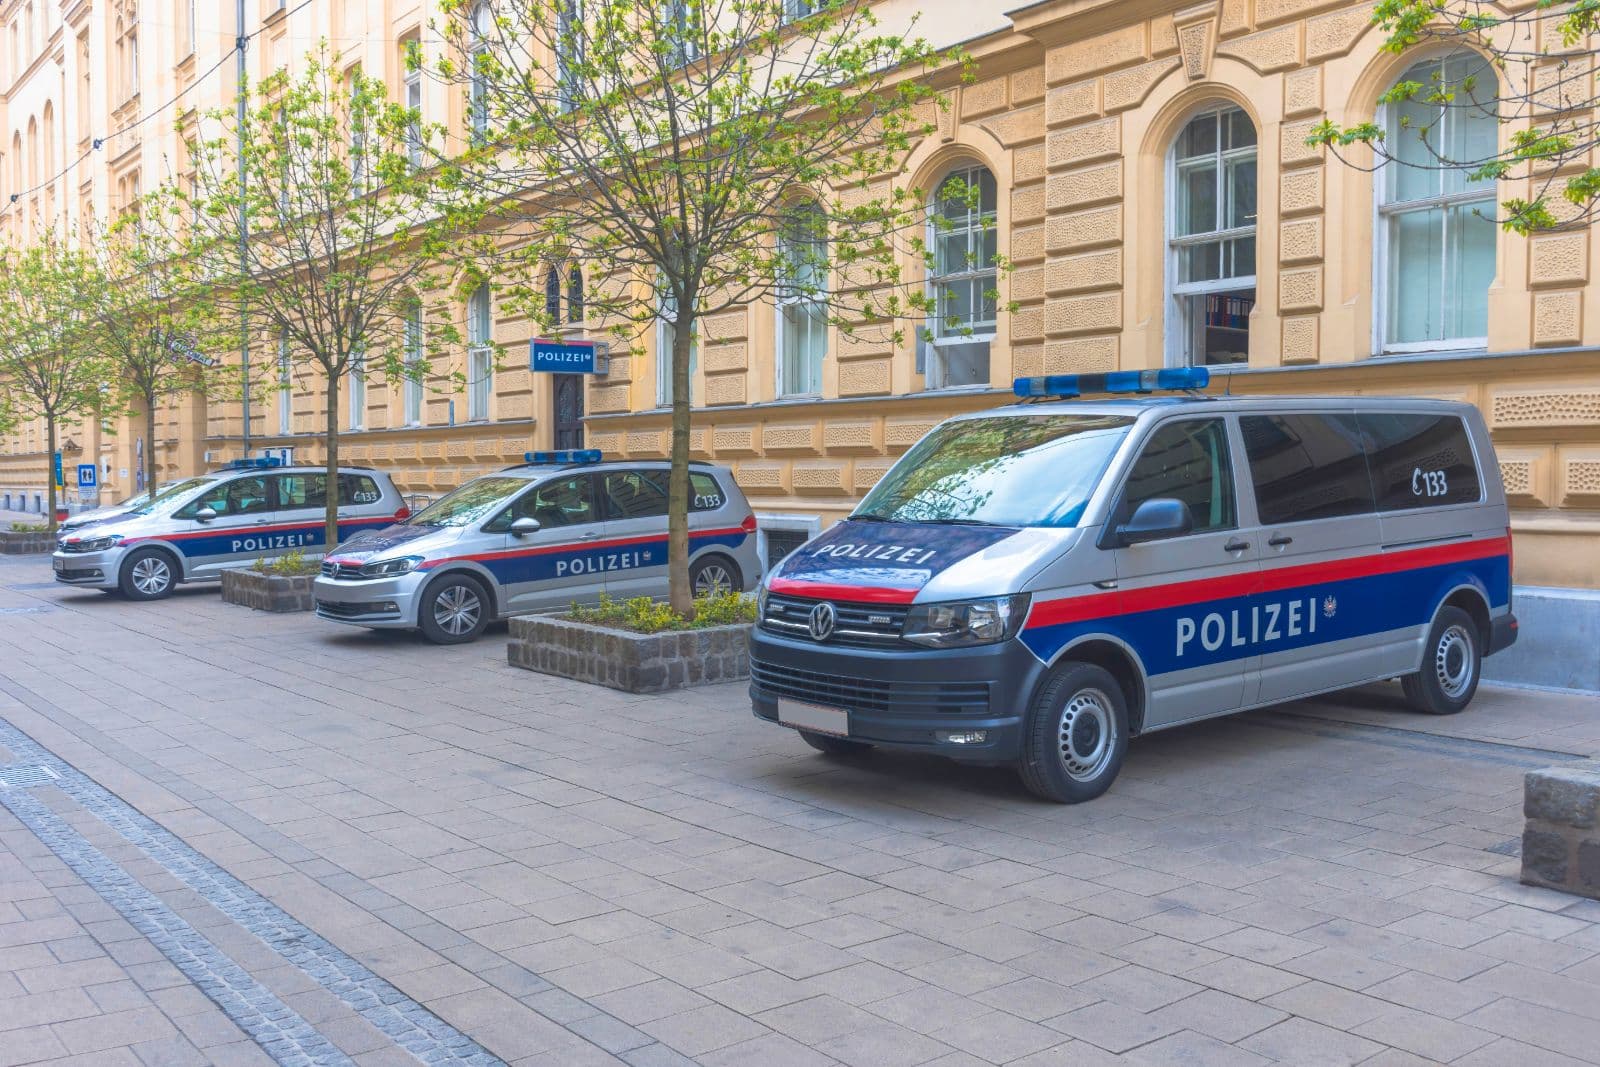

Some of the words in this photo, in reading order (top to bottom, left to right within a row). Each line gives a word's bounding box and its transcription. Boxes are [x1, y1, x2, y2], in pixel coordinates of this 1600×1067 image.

[537, 351, 584, 363] POLIZEI
[1422, 470, 1448, 497] 133
[361, 491, 377, 502] 133
[702, 494, 721, 508] 133
[232, 534, 303, 552] POLIZEI
[556, 551, 639, 577] POLIZEI
[811, 544, 936, 565] POLIZEI
[1176, 597, 1316, 657] POLIZEI
